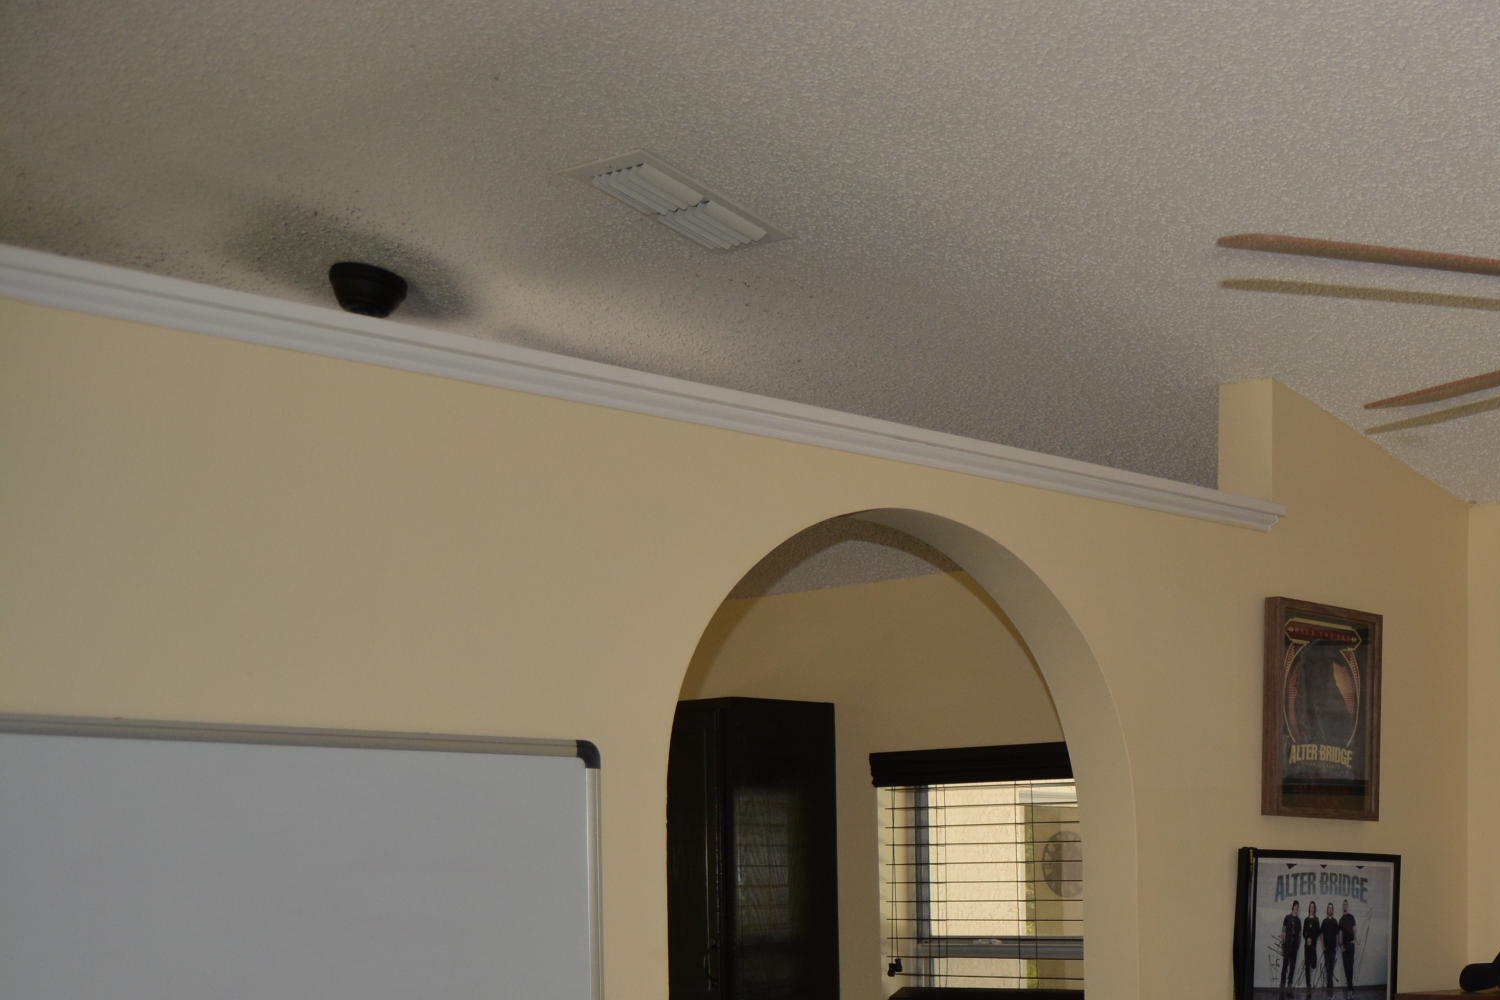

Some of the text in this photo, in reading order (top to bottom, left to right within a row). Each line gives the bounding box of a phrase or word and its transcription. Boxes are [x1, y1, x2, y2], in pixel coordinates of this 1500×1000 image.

[1289, 743, 1317, 765] ALTER
[1318, 744, 1354, 769] BRIDGE
[1273, 871, 1369, 905] ALTER BRIDGE
